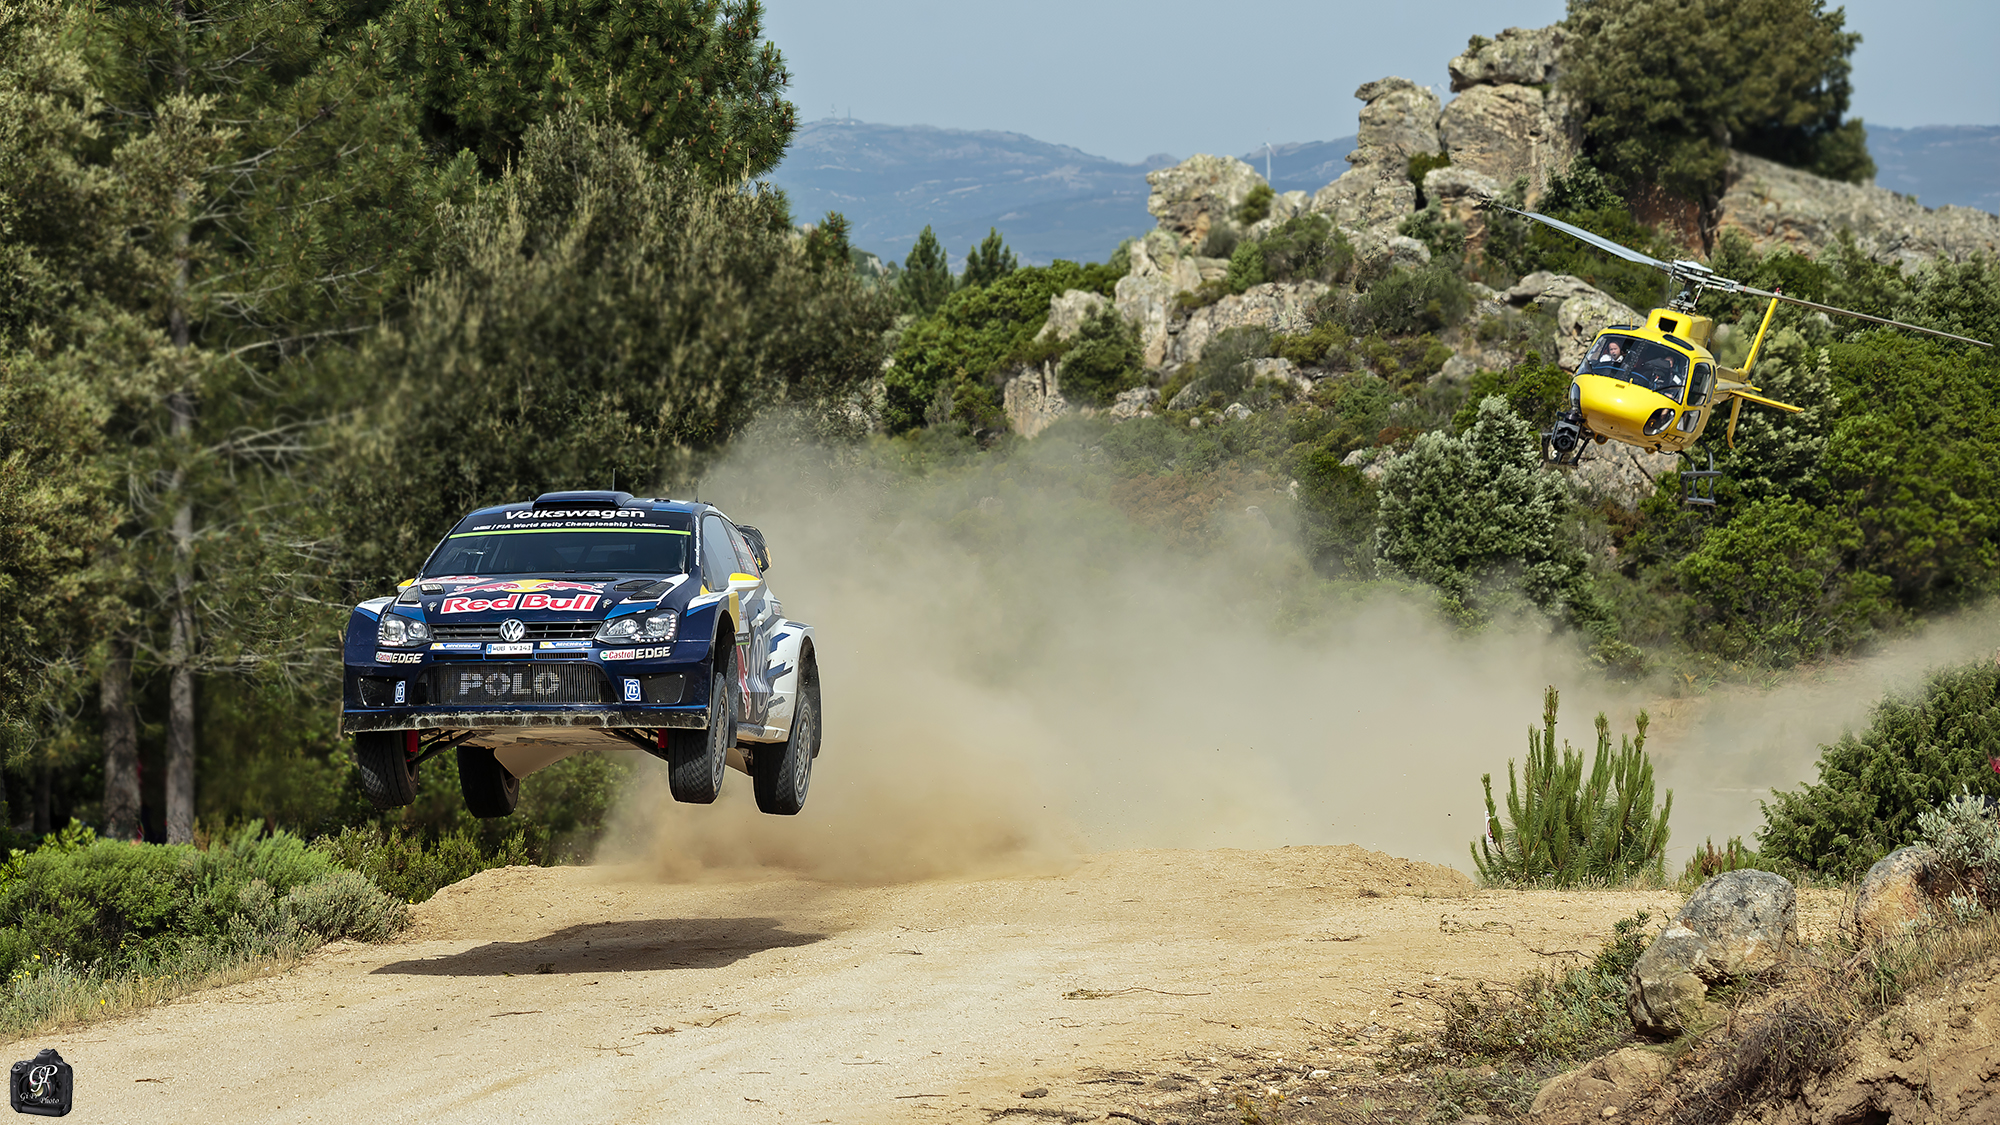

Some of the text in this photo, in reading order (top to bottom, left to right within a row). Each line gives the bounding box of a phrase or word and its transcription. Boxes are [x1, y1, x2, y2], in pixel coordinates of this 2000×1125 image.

[505, 510, 645, 519] Volkswagen
[442, 594, 599, 613] Red Bull
[391, 653, 424, 664] EDGE
[608, 646, 671, 660] Castrol EDGE
[459, 672, 560, 696] POLO
